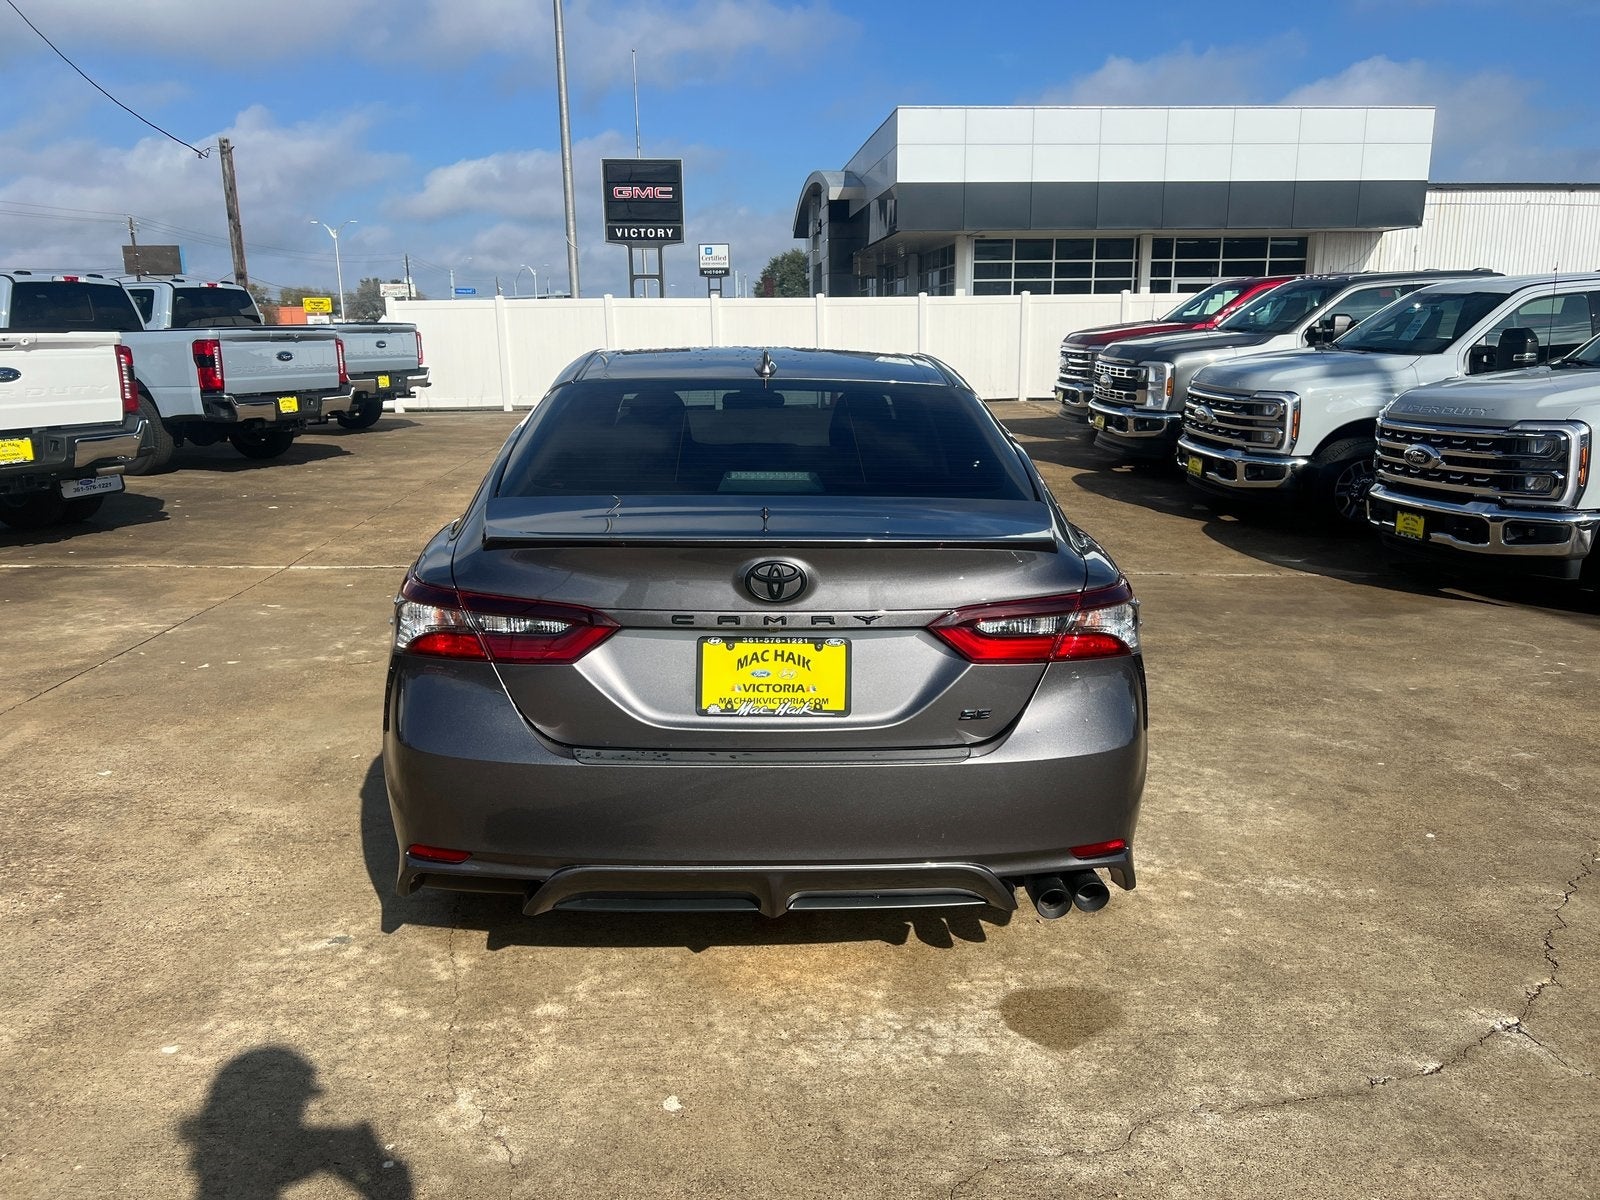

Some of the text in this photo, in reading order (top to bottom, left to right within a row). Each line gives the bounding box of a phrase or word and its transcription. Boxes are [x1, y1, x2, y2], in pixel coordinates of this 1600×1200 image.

[613, 186, 673, 199] GMC
[615, 228, 674, 238] VICTORY
[24, 384, 110, 398] DUTY
[1441, 406, 1489, 416] DUTY
[671, 615, 884, 625] CAMRY
[736, 649, 812, 671] MAC HAIK
[742, 683, 806, 693] VICTORIA
[736, 701, 816, 716] Mac Haik
[958, 708, 993, 720] SE
